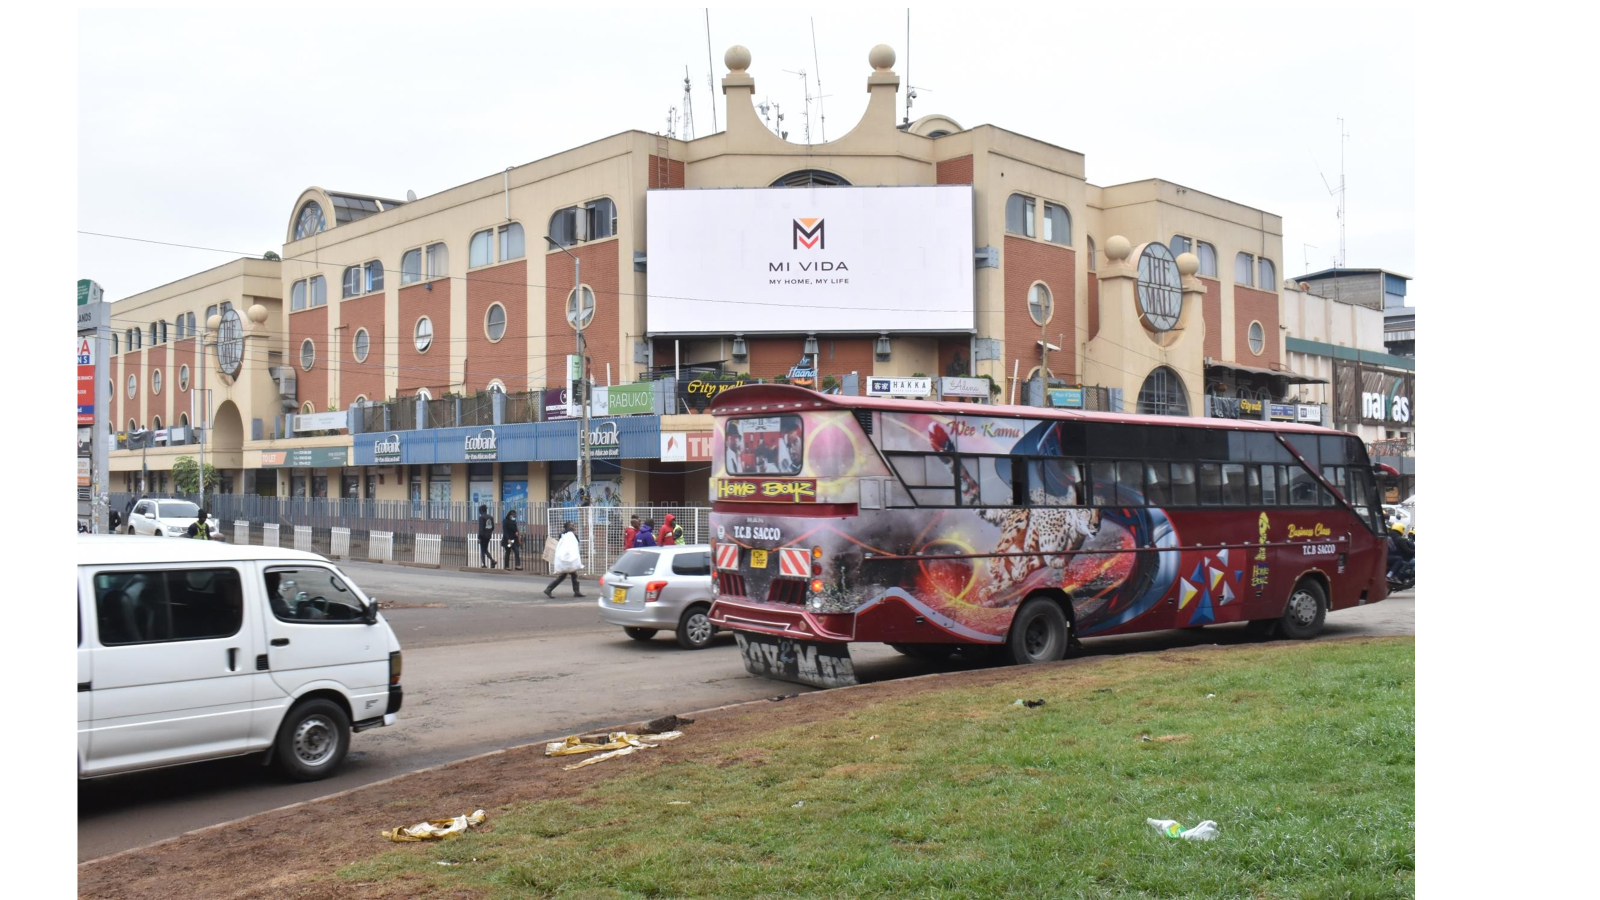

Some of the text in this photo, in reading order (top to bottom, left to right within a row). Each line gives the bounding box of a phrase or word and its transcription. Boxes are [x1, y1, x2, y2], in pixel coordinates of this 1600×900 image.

[769, 261, 849, 272] MI VIDA
[1142, 252, 1174, 289] THE
[1144, 286, 1178, 321] MALL
[688, 380, 716, 398] City
[893, 381, 927, 389] HAKKA
[609, 391, 648, 409] RABUKO
[1362, 377, 1410, 422] naivas
[580, 422, 620, 445] Eobank
[947, 420, 1020, 438] Wee Kamu
[375, 434, 401, 453] Ecobank
[465, 429, 497, 450] Ecobank
[717, 480, 816, 503] Home Boyz
[753, 527, 780, 541] SACCO
[1287, 522, 1332, 538] Business Class
[1317, 544, 1336, 554] SACCO
